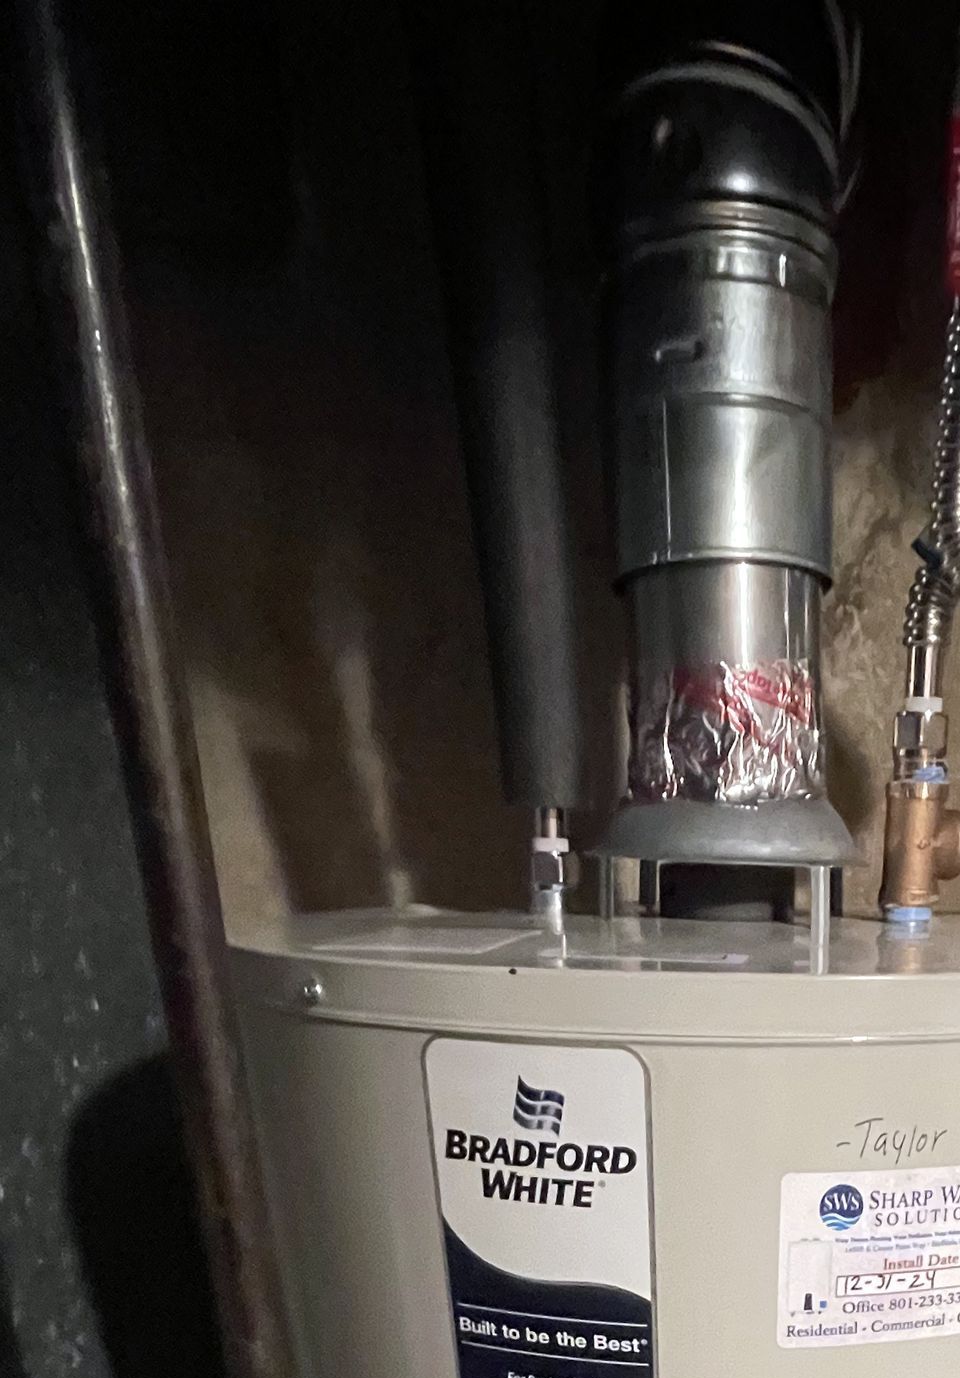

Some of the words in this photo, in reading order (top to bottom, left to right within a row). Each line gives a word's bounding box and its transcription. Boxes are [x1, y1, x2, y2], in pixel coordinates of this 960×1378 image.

[445, 1128, 637, 1176] BRADFORD
[482, 1168, 594, 1208] WHITE
[823, 1192, 860, 1212] SWS
[869, 1190, 933, 1210] SHARP
[883, 1254, 923, 1271] Install
[928, 1254, 959, 1267] Date
[842, 1300, 885, 1314] Office
[459, 1316, 498, 1337] Built
[502, 1324, 521, 1340] to
[525, 1327, 550, 1344] be
[556, 1331, 587, 1349] the
[593, 1334, 641, 1352] Best
[786, 1321, 858, 1338] Residential
[871, 1313, 945, 1331] Commercial
